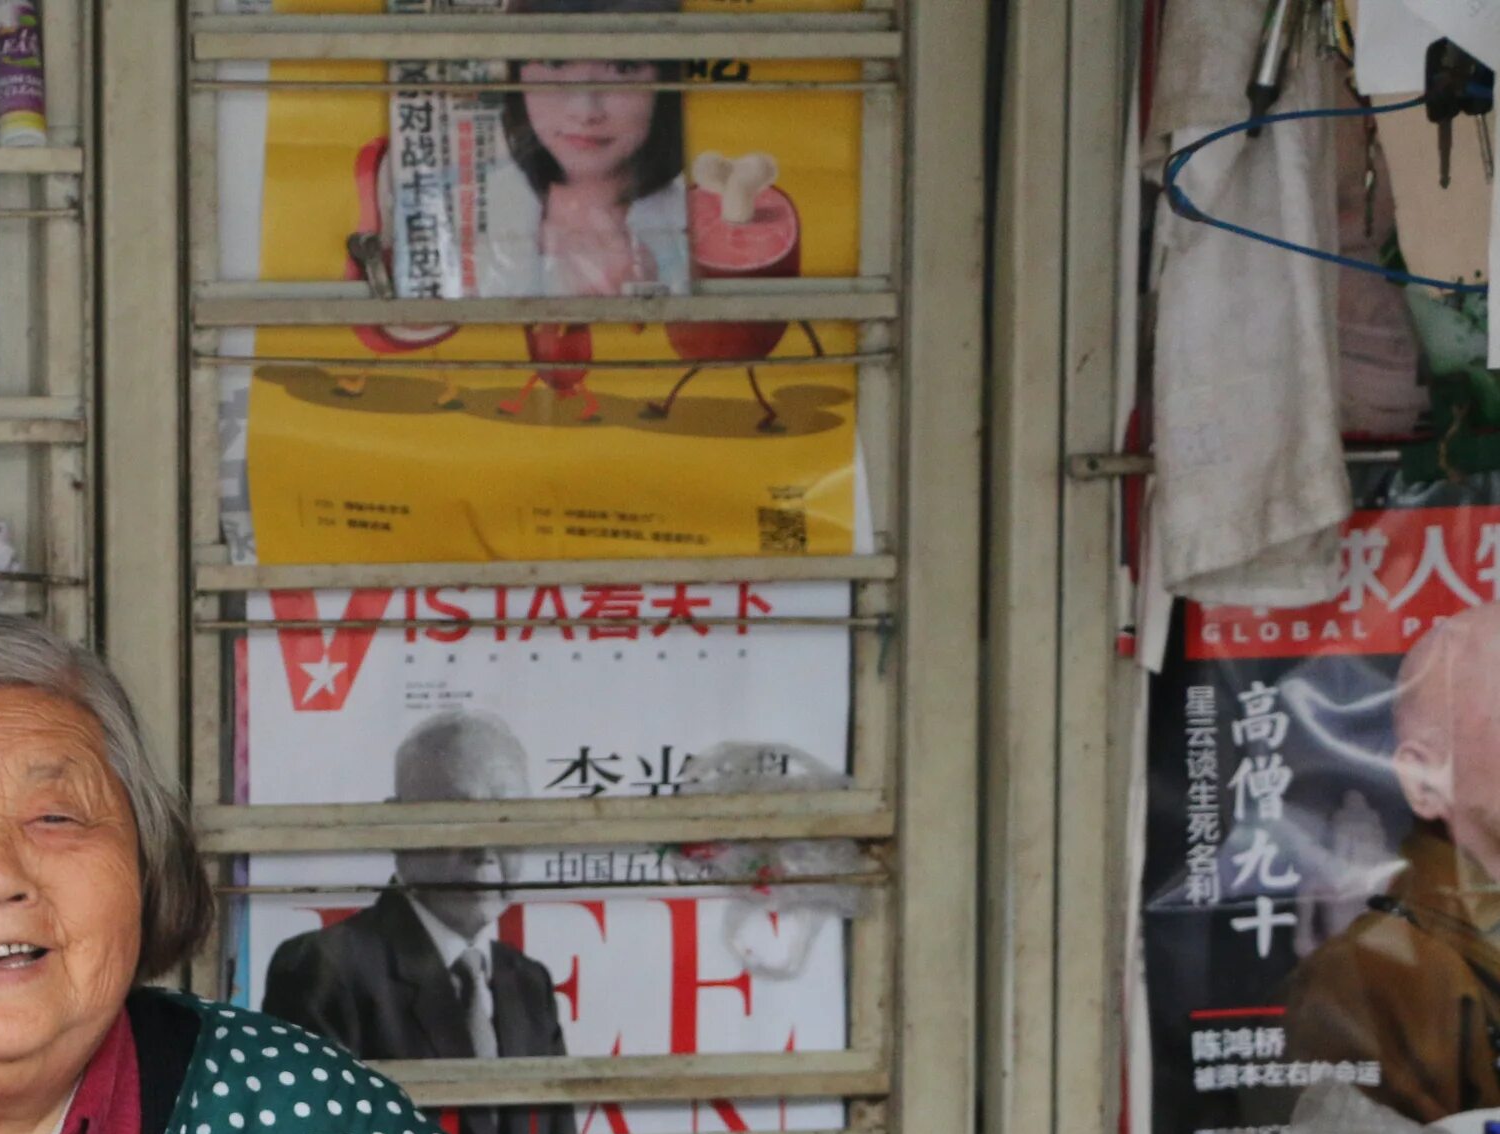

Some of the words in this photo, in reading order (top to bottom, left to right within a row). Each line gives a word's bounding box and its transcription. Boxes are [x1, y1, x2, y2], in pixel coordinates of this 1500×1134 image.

[1201, 617, 1368, 646] GLOBAL
[1227, 680, 1301, 958] 高僧九十
[1191, 1026, 1286, 1062] 陈鸿桥
